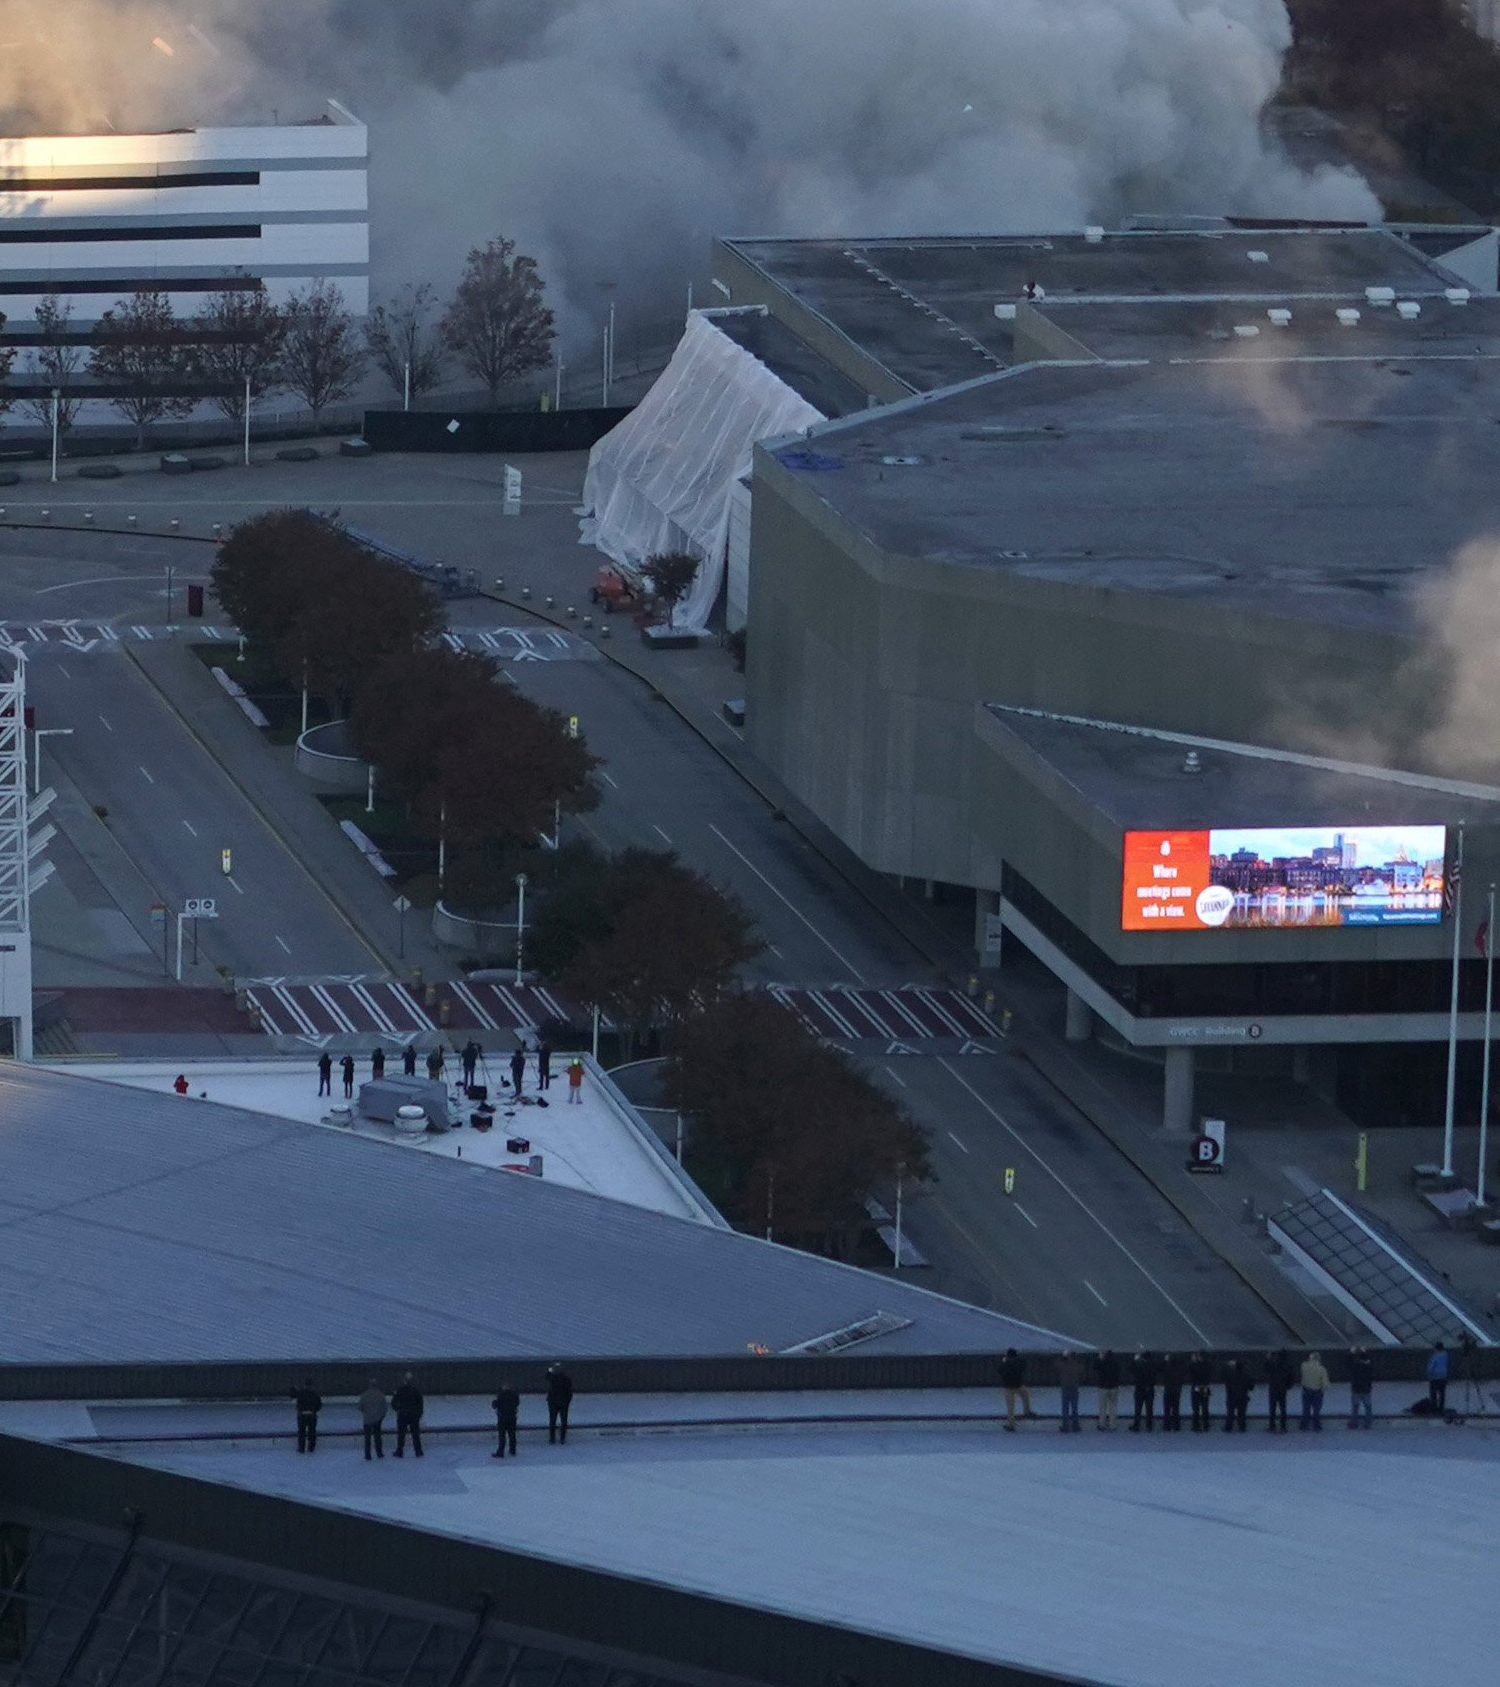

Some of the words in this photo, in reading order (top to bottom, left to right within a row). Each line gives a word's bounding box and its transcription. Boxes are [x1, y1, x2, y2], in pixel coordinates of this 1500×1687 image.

[1152, 864, 1177, 878] Where
[1142, 903, 1159, 917] with
[1198, 1141, 1213, 1161] B
